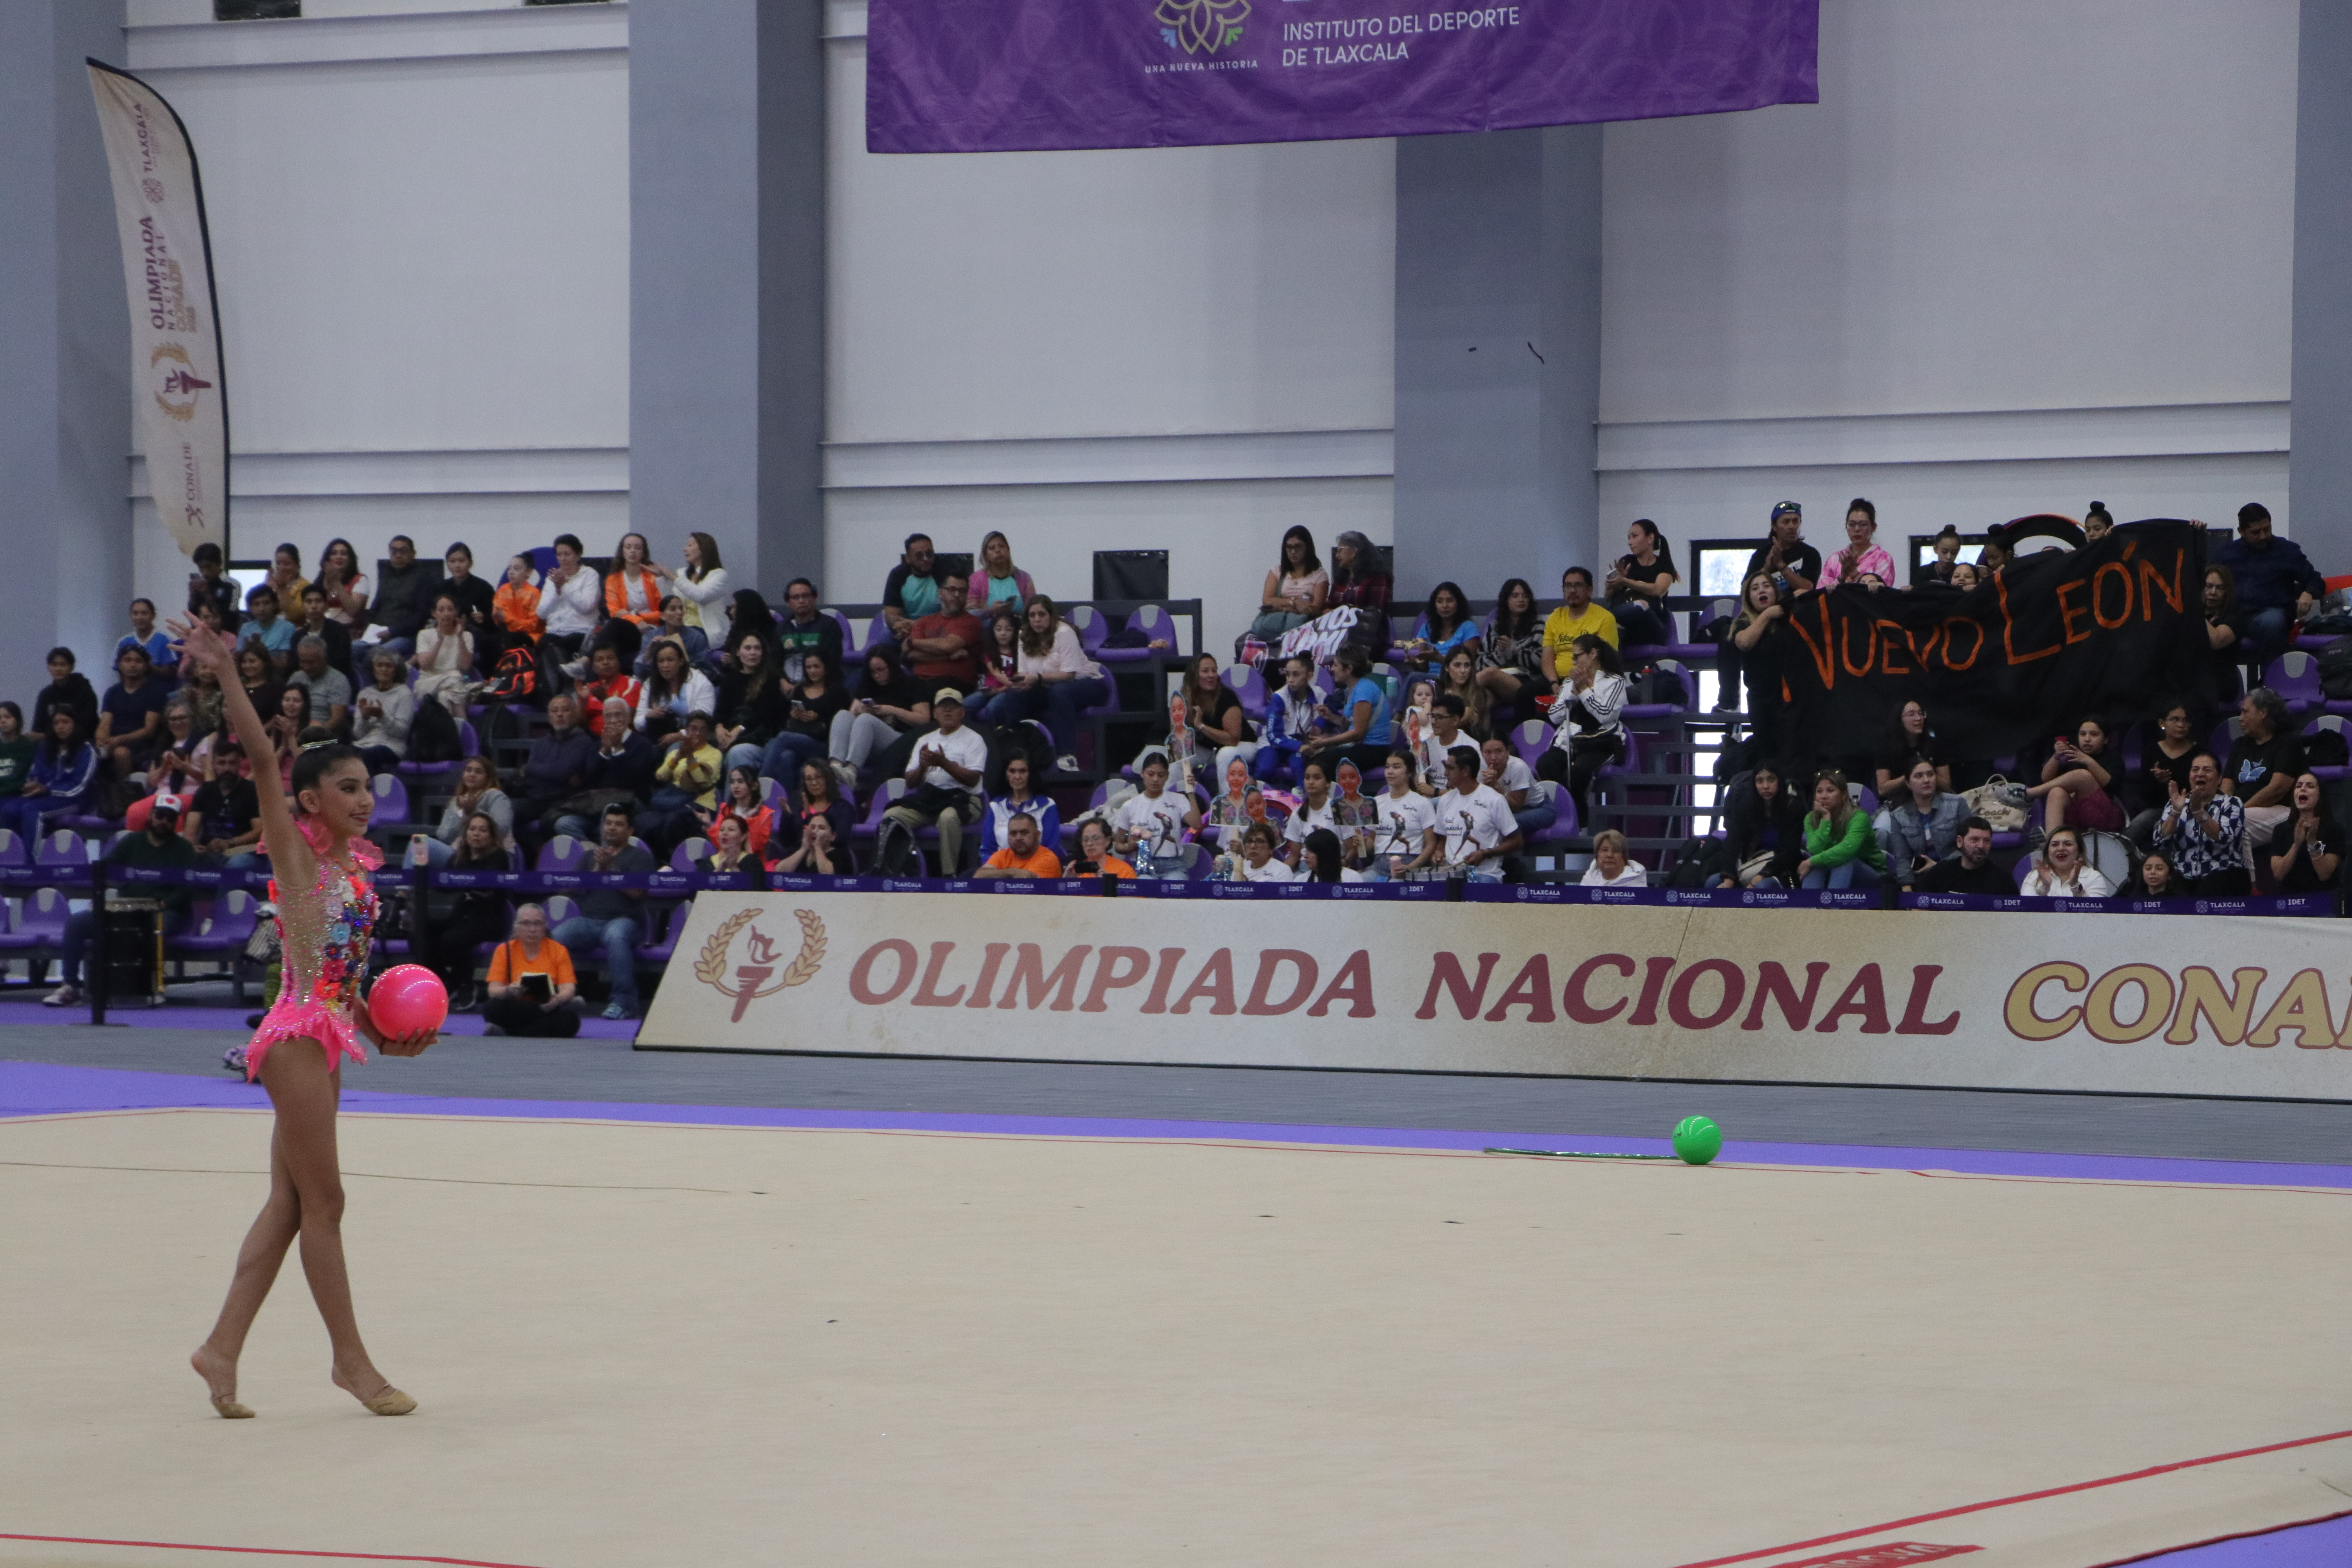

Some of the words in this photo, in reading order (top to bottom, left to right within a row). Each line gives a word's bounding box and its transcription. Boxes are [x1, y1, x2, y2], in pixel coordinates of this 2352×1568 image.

[1284, 18, 1383, 40] INSTITUTO
[1389, 15, 1423, 34] DEL
[1429, 6, 1519, 32] DEPORTE
[1144, 65, 1165, 73] UNA
[1170, 62, 1204, 71] NUEVA
[1208, 60, 1258, 69] HISTORIA
[1282, 48, 1307, 66] DE
[1313, 42, 1409, 64] TLAXCALA
[139, 216, 165, 329] OLIMPIADA
[1995, 541, 2183, 664] LEÓN
[1977, 808, 2011, 816] Coach
[848, 938, 1376, 1018] OLIMPIADA
[1414, 951, 1961, 1035] NACIONAL
[2003, 960, 2352, 1049] CONA
